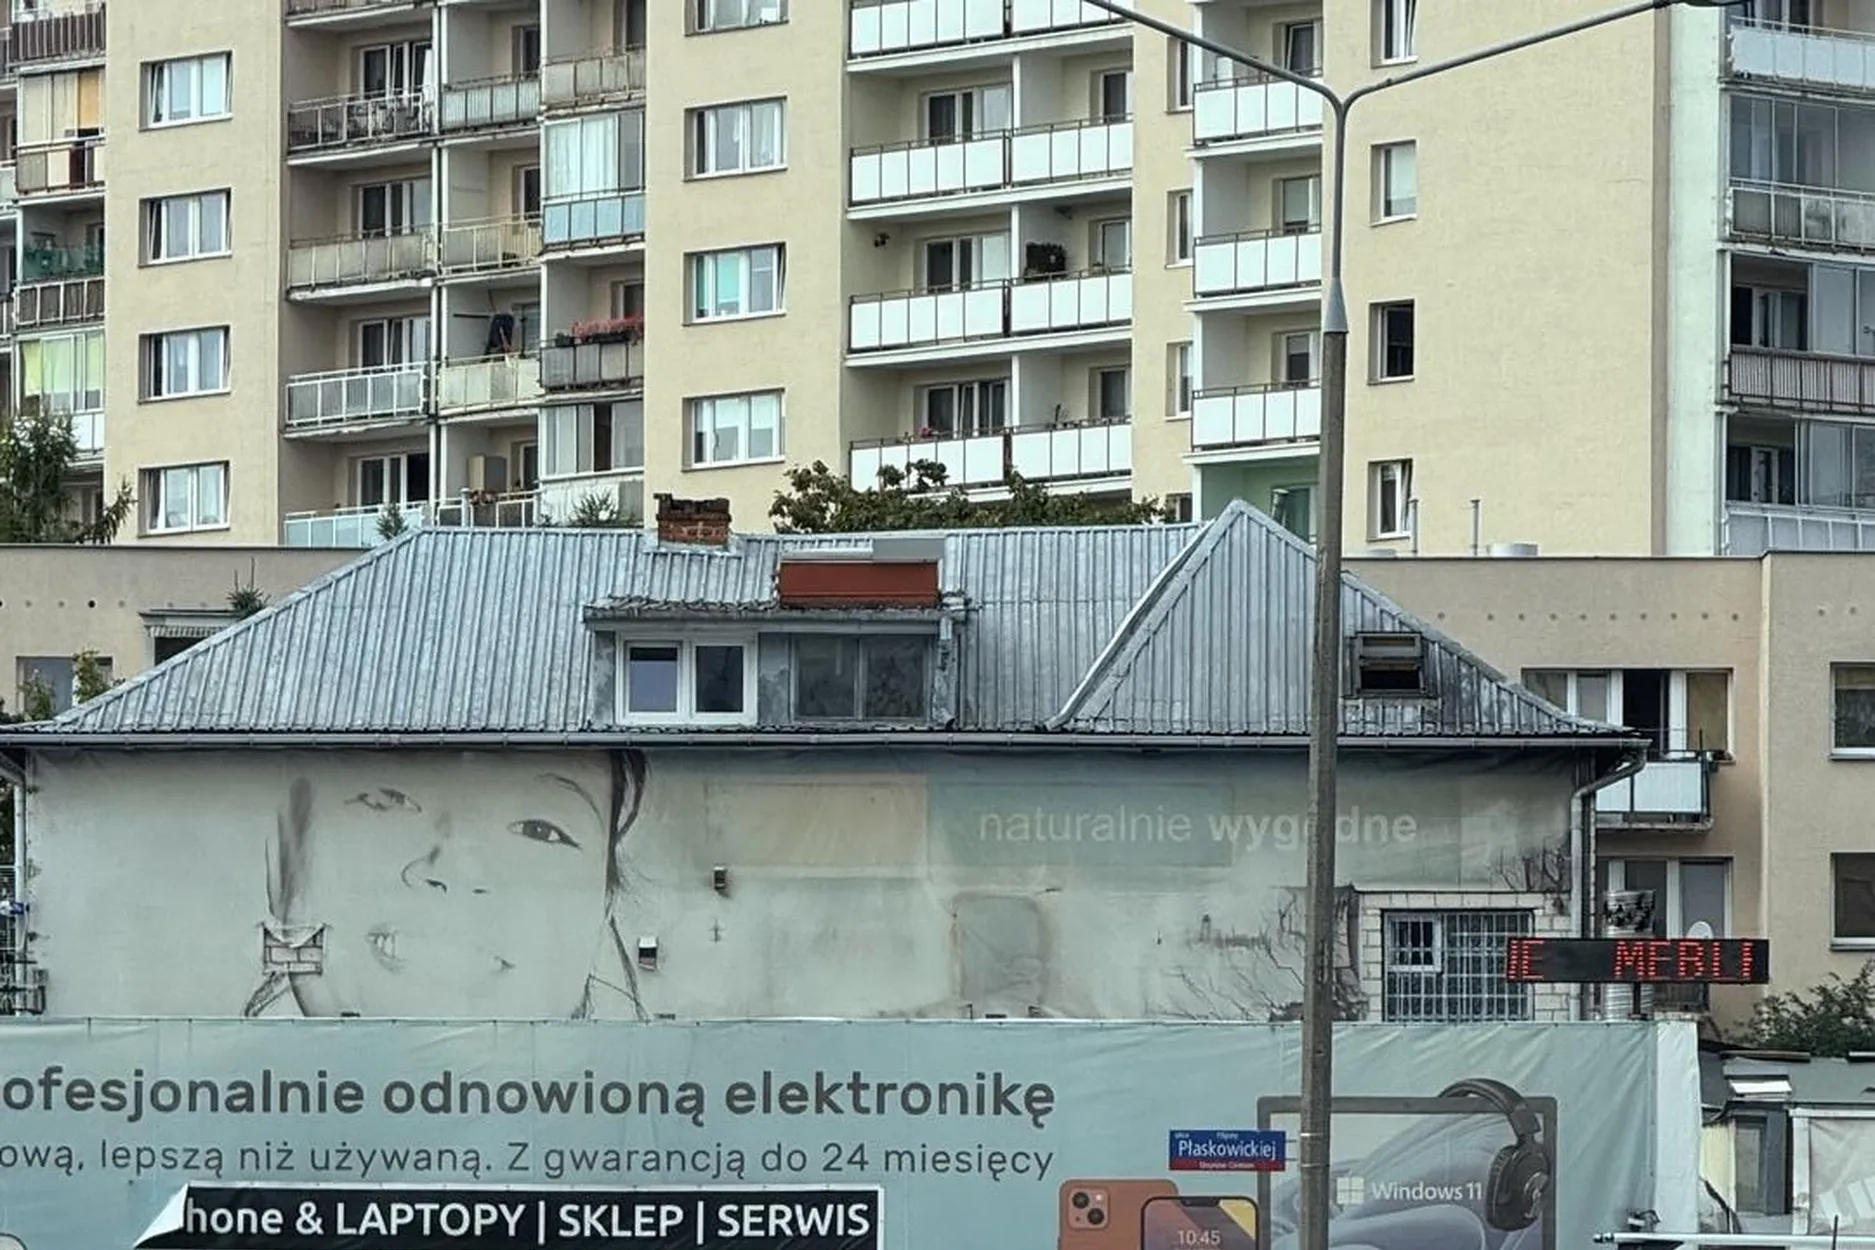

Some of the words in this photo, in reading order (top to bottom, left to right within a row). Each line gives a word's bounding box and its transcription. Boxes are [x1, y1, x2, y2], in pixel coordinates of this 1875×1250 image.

[980, 806, 1192, 842] naturalnie
[1208, 806, 1418, 852] wygdne
[2, 1065, 364, 1123] ofesjonalnie
[383, 1070, 706, 1127] odnowioną
[725, 1070, 1055, 1129] elektronikę
[101, 1139, 224, 1178] lepszą
[239, 1141, 294, 1170] niż
[310, 1141, 492, 1179] używaną.
[508, 1142, 529, 1171] Z
[544, 1142, 745, 1180] gwarancją
[761, 1143, 807, 1172] do
[822, 1143, 869, 1172] 24
[884, 1144, 1054, 1181] miesięcy
[1178, 1140, 1276, 1161] Płaskowickiej
[1371, 1181, 1464, 1200] Windows
[1466, 1182, 1482, 1200] 11
[186, 1198, 284, 1234] hone
[295, 1201, 325, 1235] &
[336, 1203, 526, 1237] LAPTOPY
[558, 1204, 684, 1237] SKLEP
[717, 1204, 870, 1237] SERWIS
